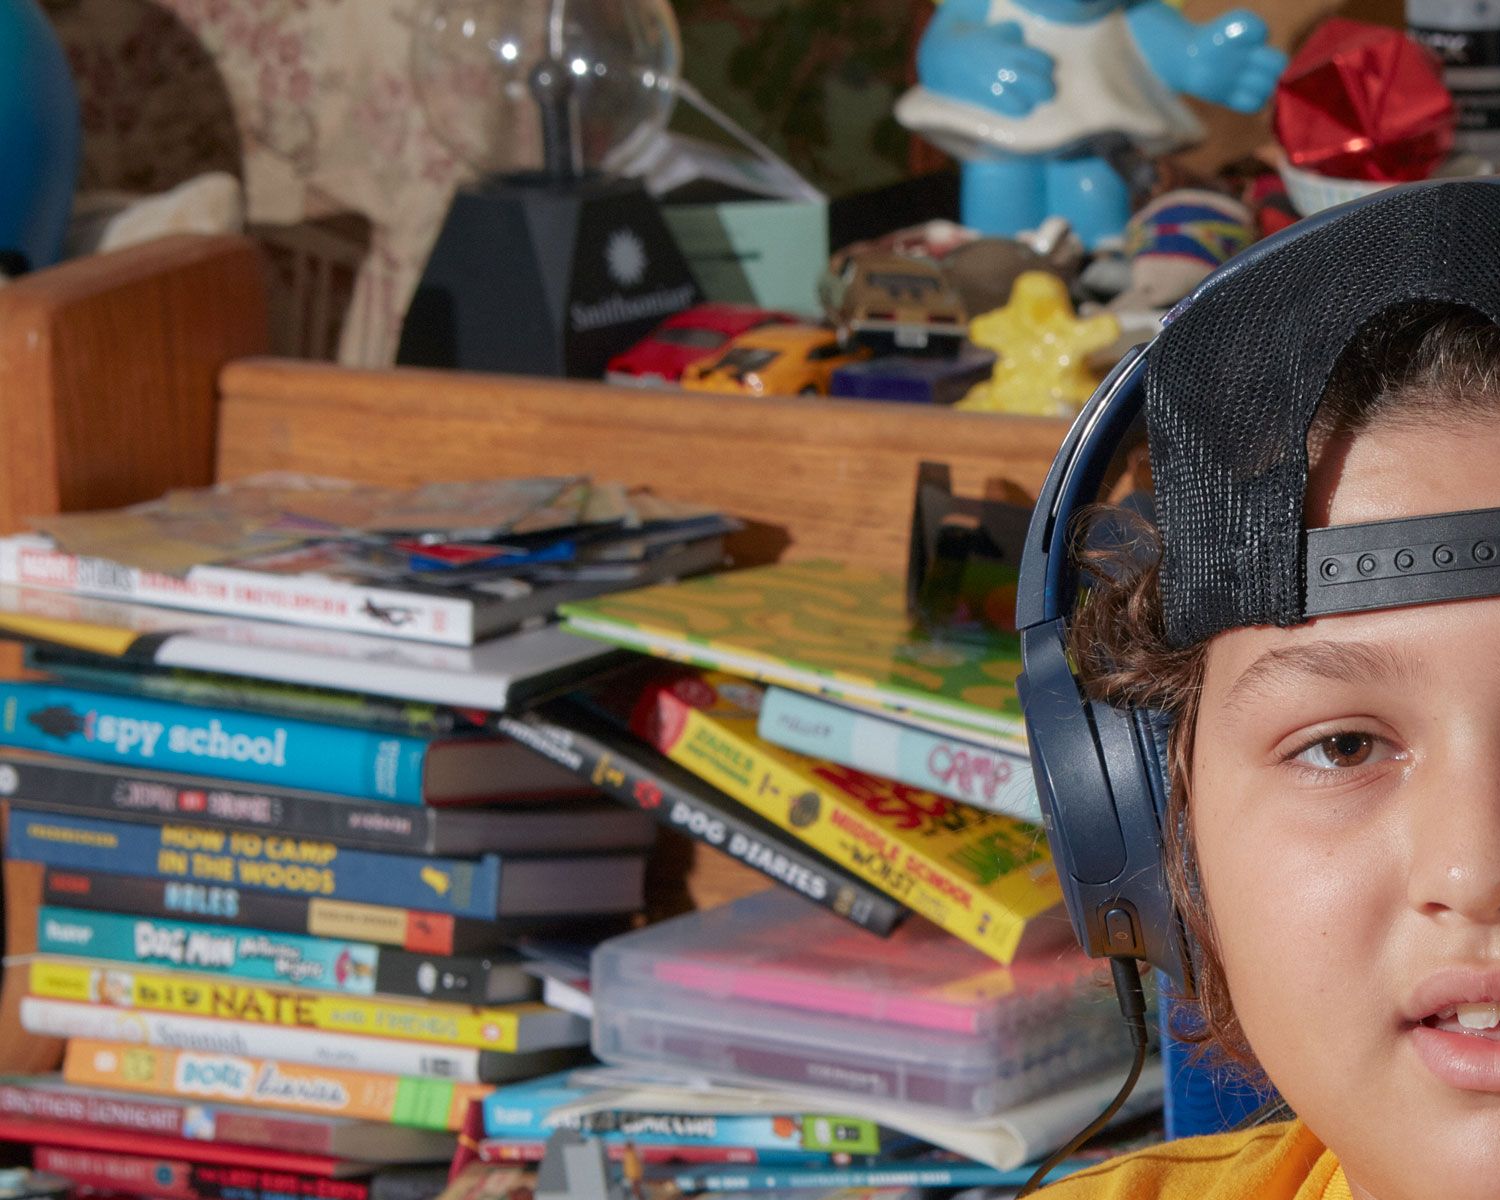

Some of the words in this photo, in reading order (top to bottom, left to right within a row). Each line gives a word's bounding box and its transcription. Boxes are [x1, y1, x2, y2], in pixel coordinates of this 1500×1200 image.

[571, 286, 697, 332] Smithsonian
[98, 713, 162, 757] spy
[168, 720, 287, 767] school
[161, 823, 225, 851] HOW
[230, 831, 262, 857] TO
[263, 834, 338, 865] CAMP
[669, 801, 725, 848] DOG
[728, 831, 827, 901] DIARIES
[157, 848, 189, 875] IN
[191, 853, 235, 881] THE
[238, 859, 334, 894] WOODS
[208, 983, 319, 1027] NATE
